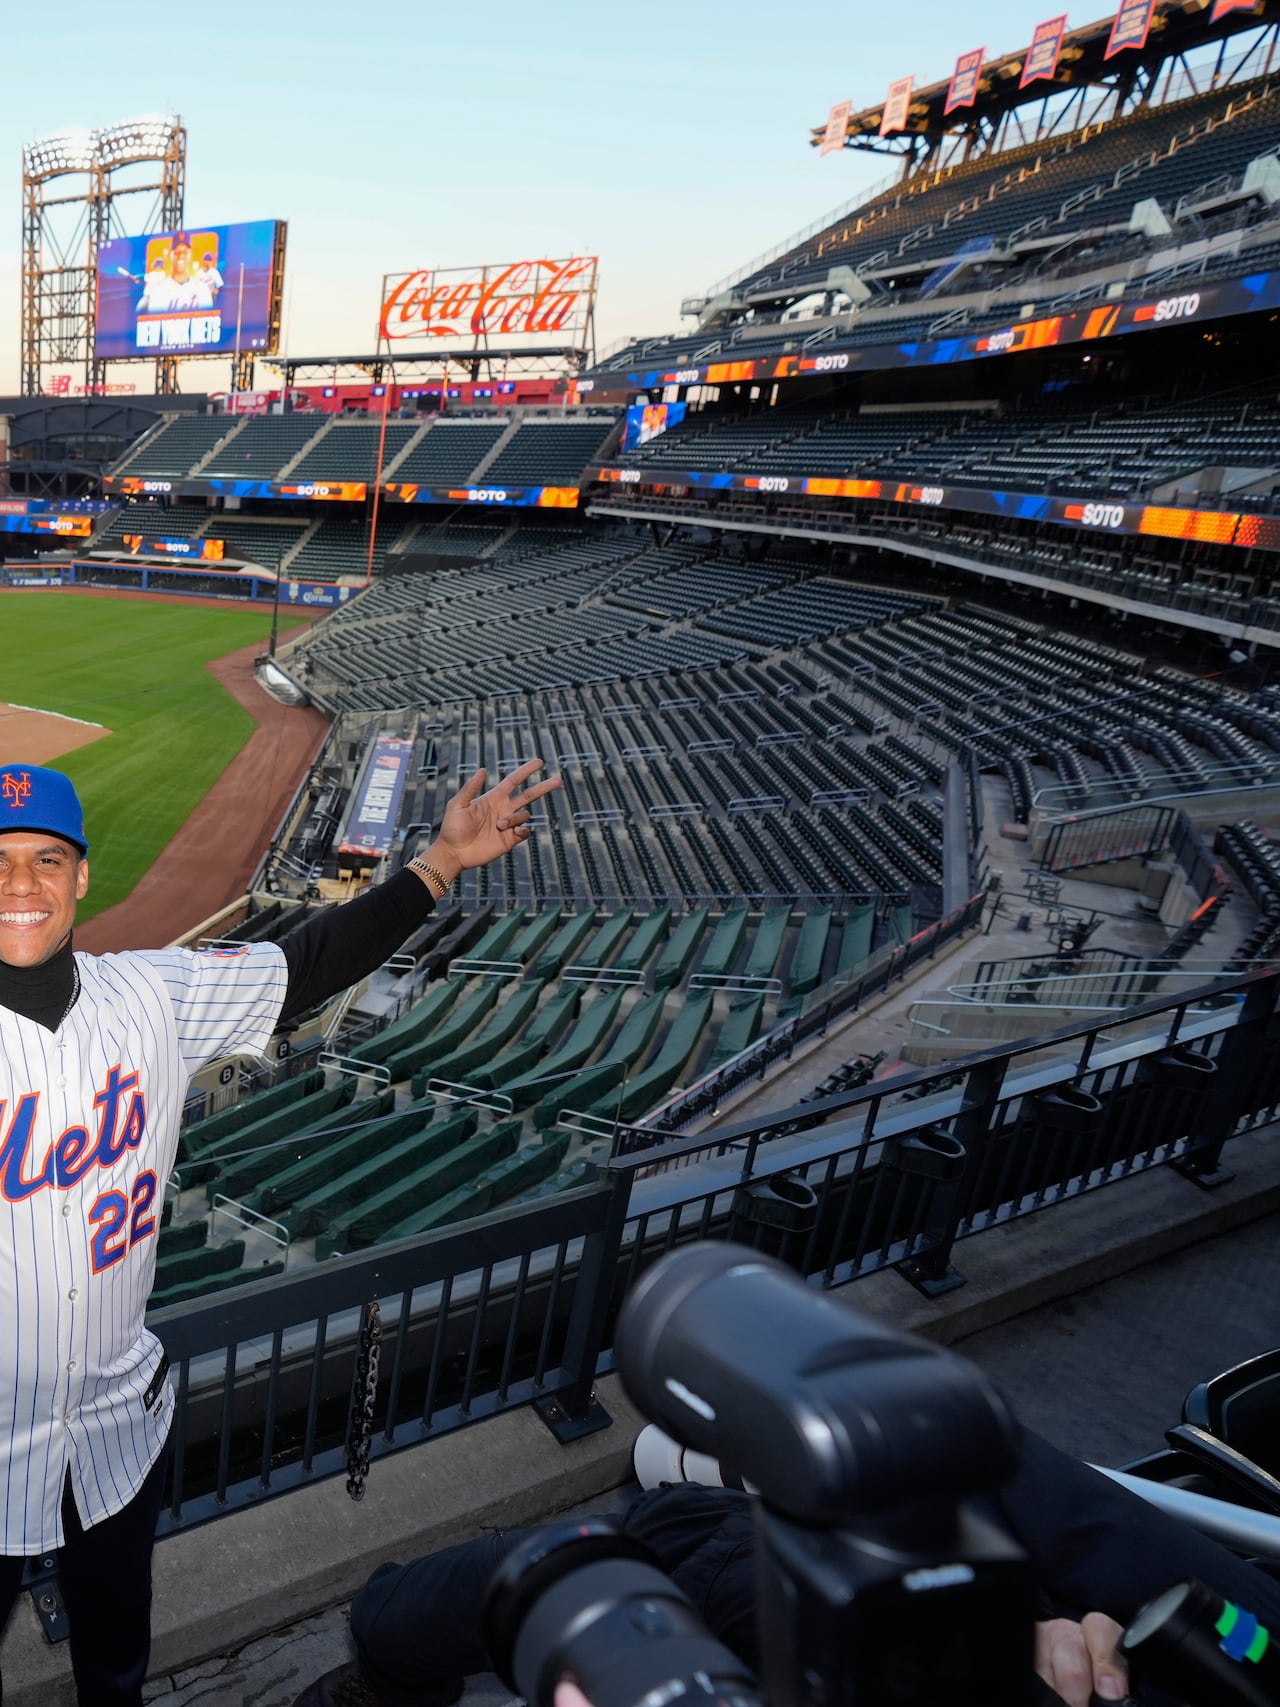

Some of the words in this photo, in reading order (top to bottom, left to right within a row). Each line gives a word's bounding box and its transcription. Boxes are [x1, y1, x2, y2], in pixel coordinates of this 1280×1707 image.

[1153, 292, 1200, 321] SOTO
[987, 331, 1014, 351] SOTO
[814, 354, 849, 370] SOTO
[675, 369, 698, 383] SOTO
[620, 471, 641, 482] SOTO
[144, 482, 171, 492] SOTO
[297, 485, 329, 496] SOTO
[758, 477, 789, 491] SOTO
[468, 490, 506, 501] SOTO
[920, 486, 944, 505] SOTO
[1081, 503, 1124, 528] SOTO
[49, 521, 73, 531] SOTO
[166, 543, 190, 553] SOTO
[303, 591, 334, 604] Corona
[280, 1043, 288, 1058] B
[223, 1067, 233, 1082] B
[88, 1168, 157, 1275] 22
